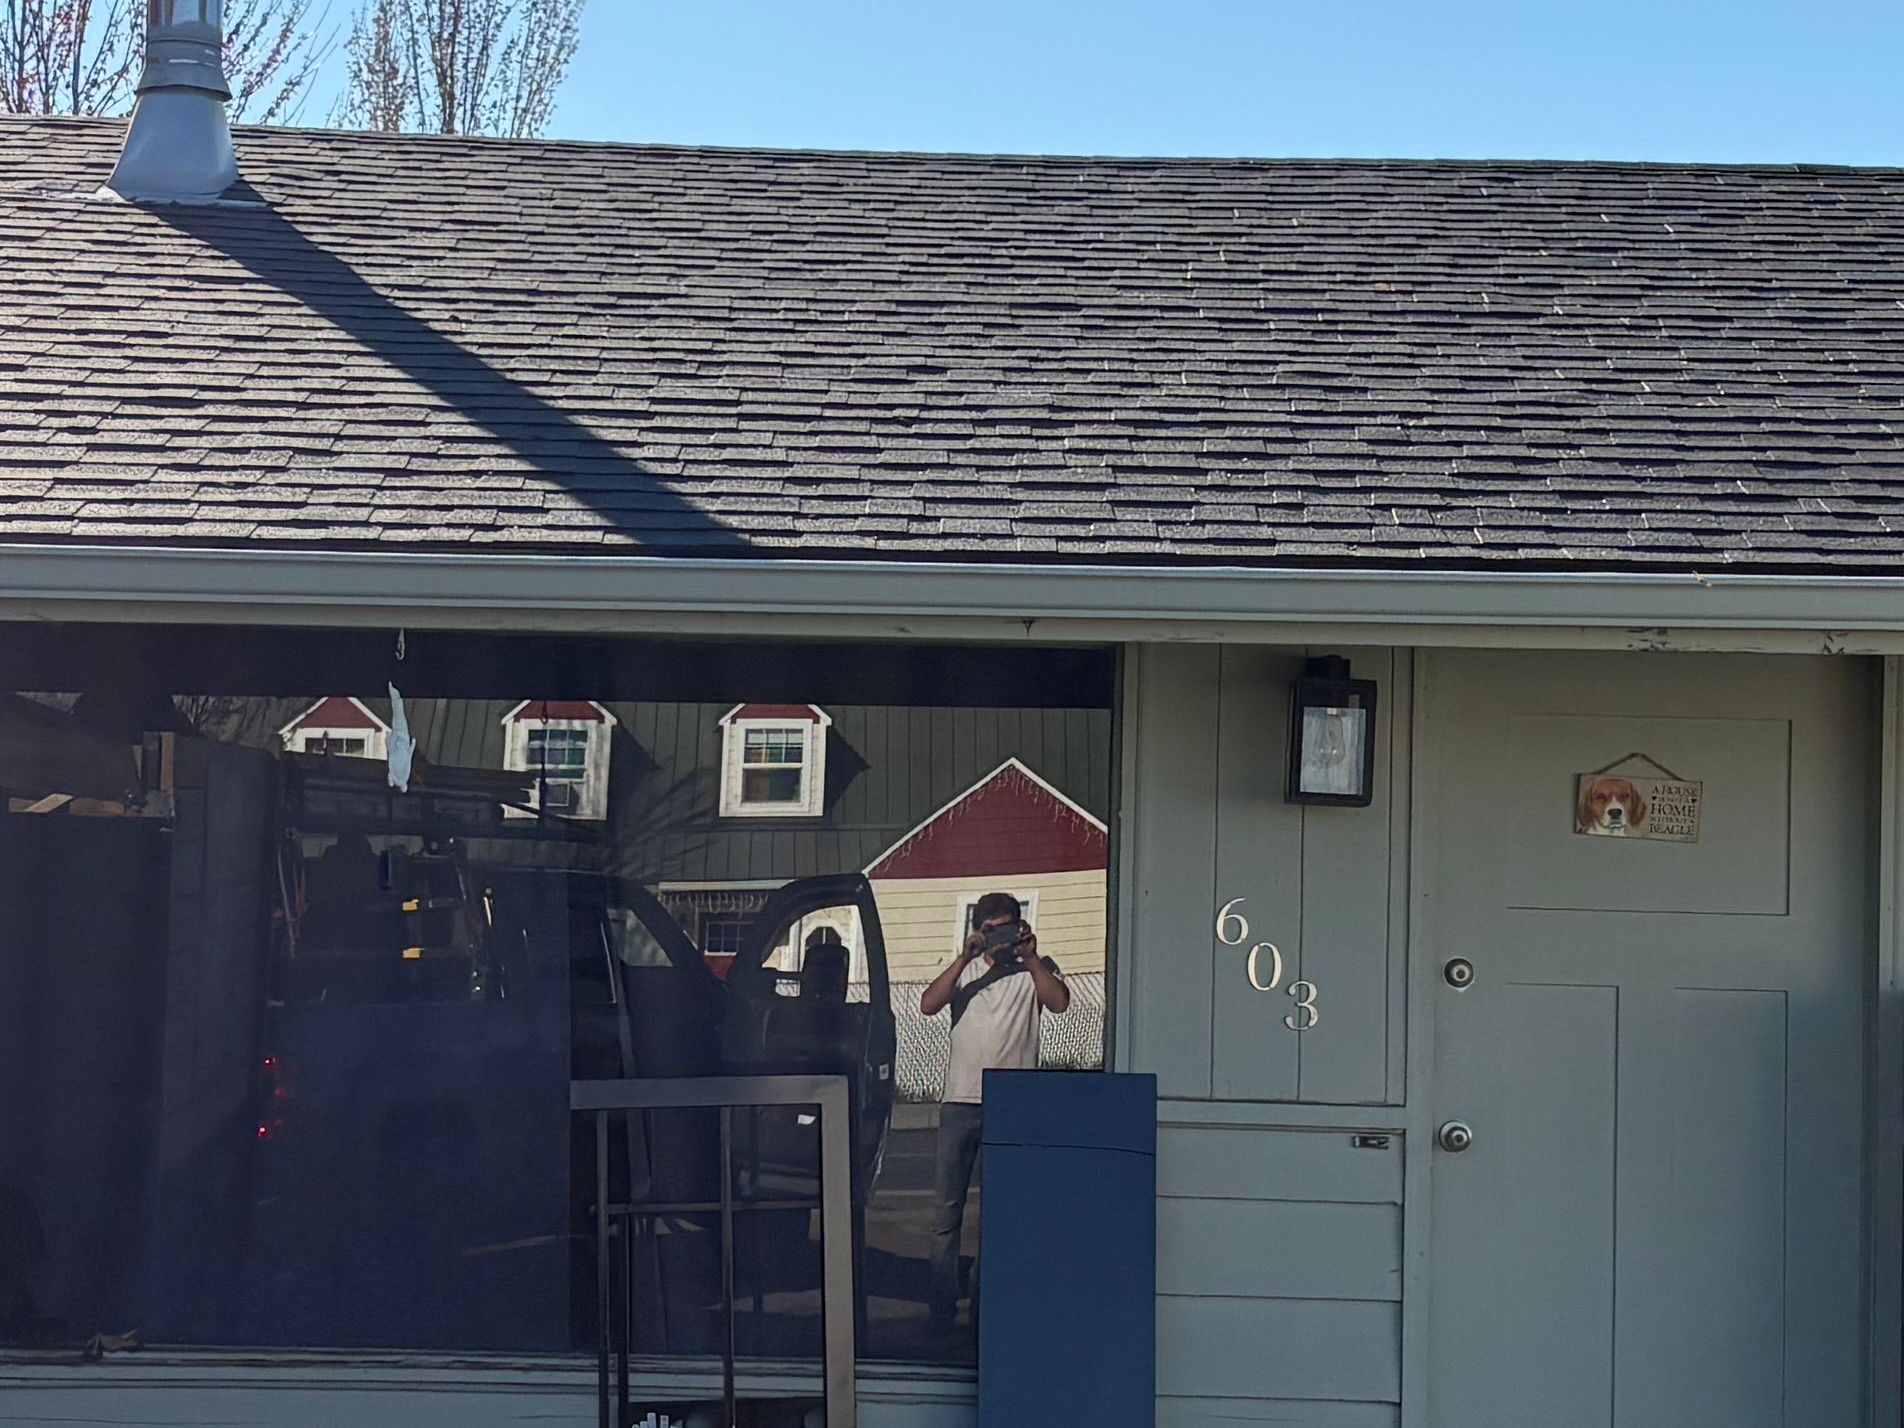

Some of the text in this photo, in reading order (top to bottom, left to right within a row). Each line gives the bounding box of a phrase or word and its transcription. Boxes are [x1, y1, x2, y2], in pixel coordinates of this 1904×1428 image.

[1651, 803, 1696, 817] HOME
[1649, 823, 1695, 836] BEAGLE
[1215, 897, 1319, 1030] 603
